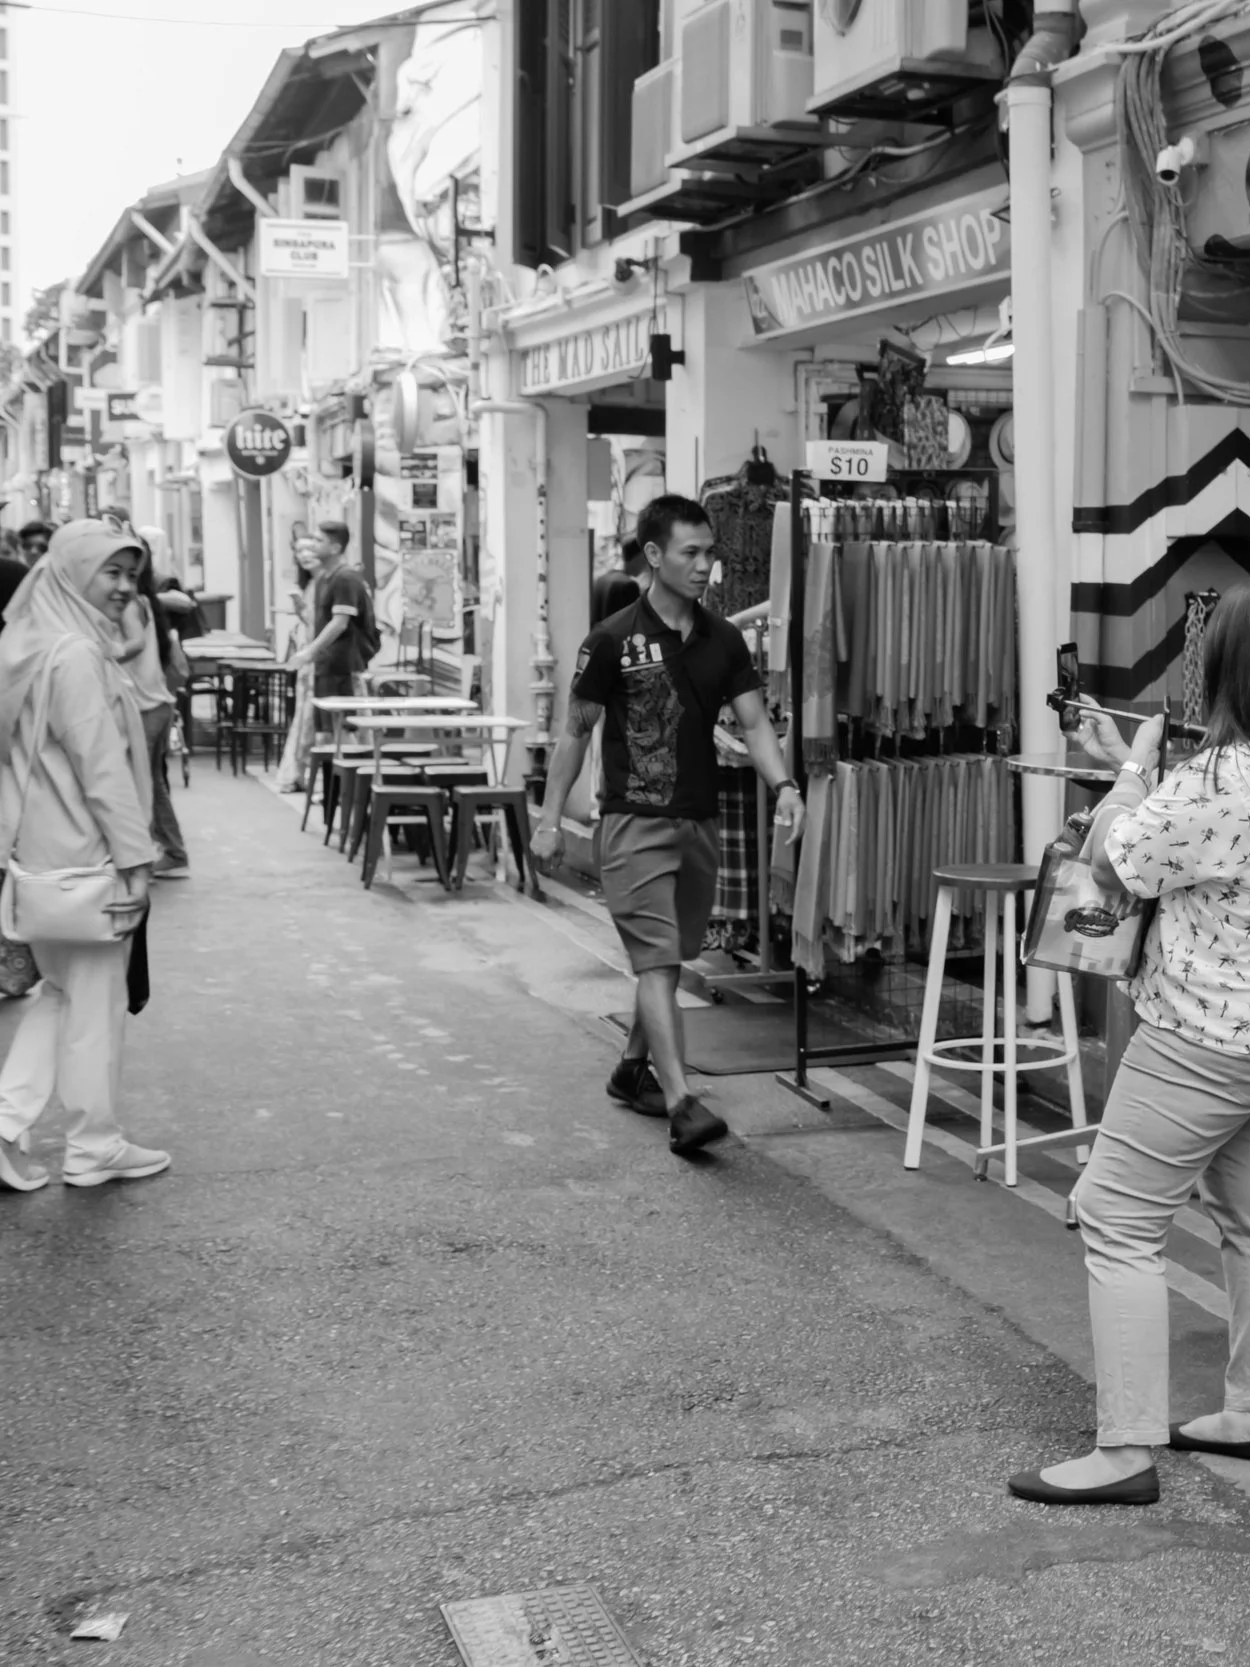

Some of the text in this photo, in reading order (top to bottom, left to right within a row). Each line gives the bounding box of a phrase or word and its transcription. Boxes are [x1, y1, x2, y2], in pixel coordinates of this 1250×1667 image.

[771, 207, 1001, 329] MAHACO SILK SHOP
[557, 330, 594, 382] MAD
[235, 423, 288, 451] hite
[829, 456, 869, 477] $10
